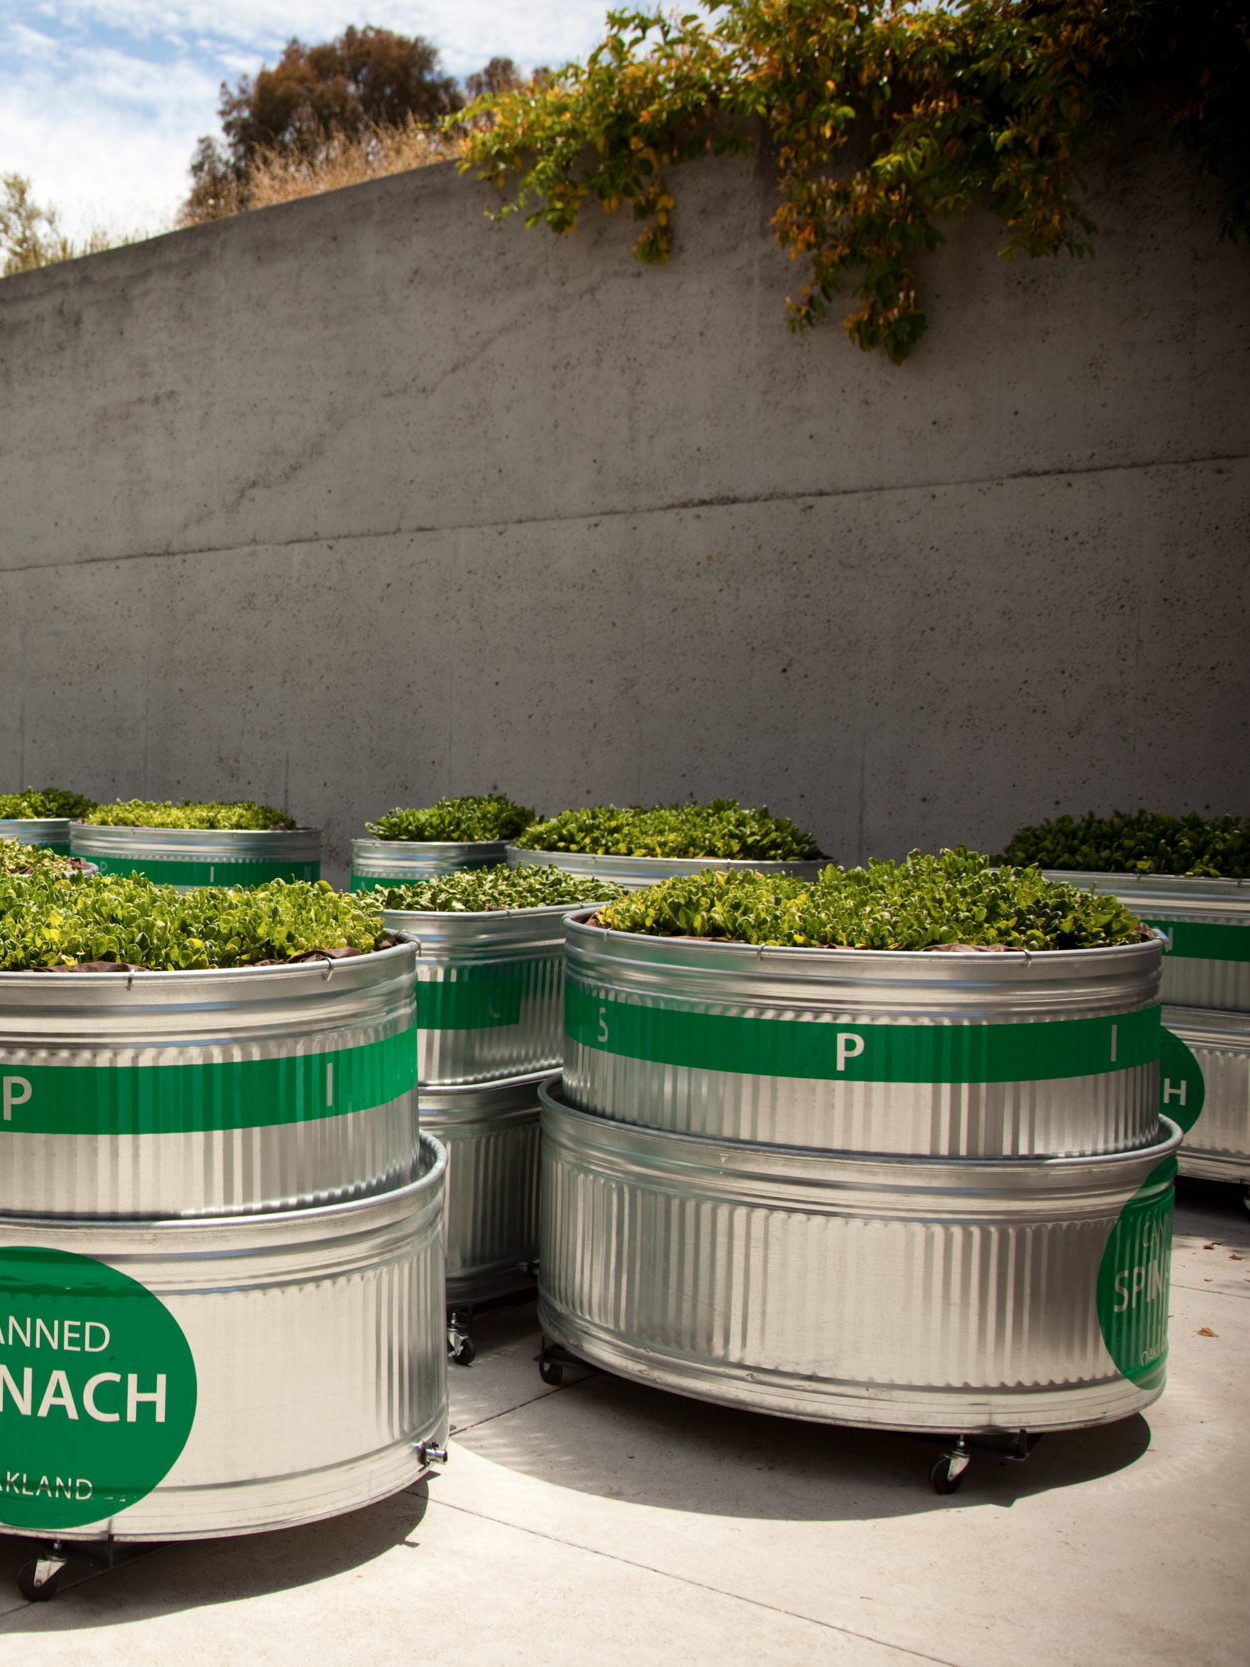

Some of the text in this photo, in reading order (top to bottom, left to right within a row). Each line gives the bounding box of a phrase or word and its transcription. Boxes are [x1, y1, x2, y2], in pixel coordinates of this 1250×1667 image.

[598, 1007, 1117, 1071] S P I
[3, 1076, 32, 1121] P
[327, 1062, 333, 1106] I
